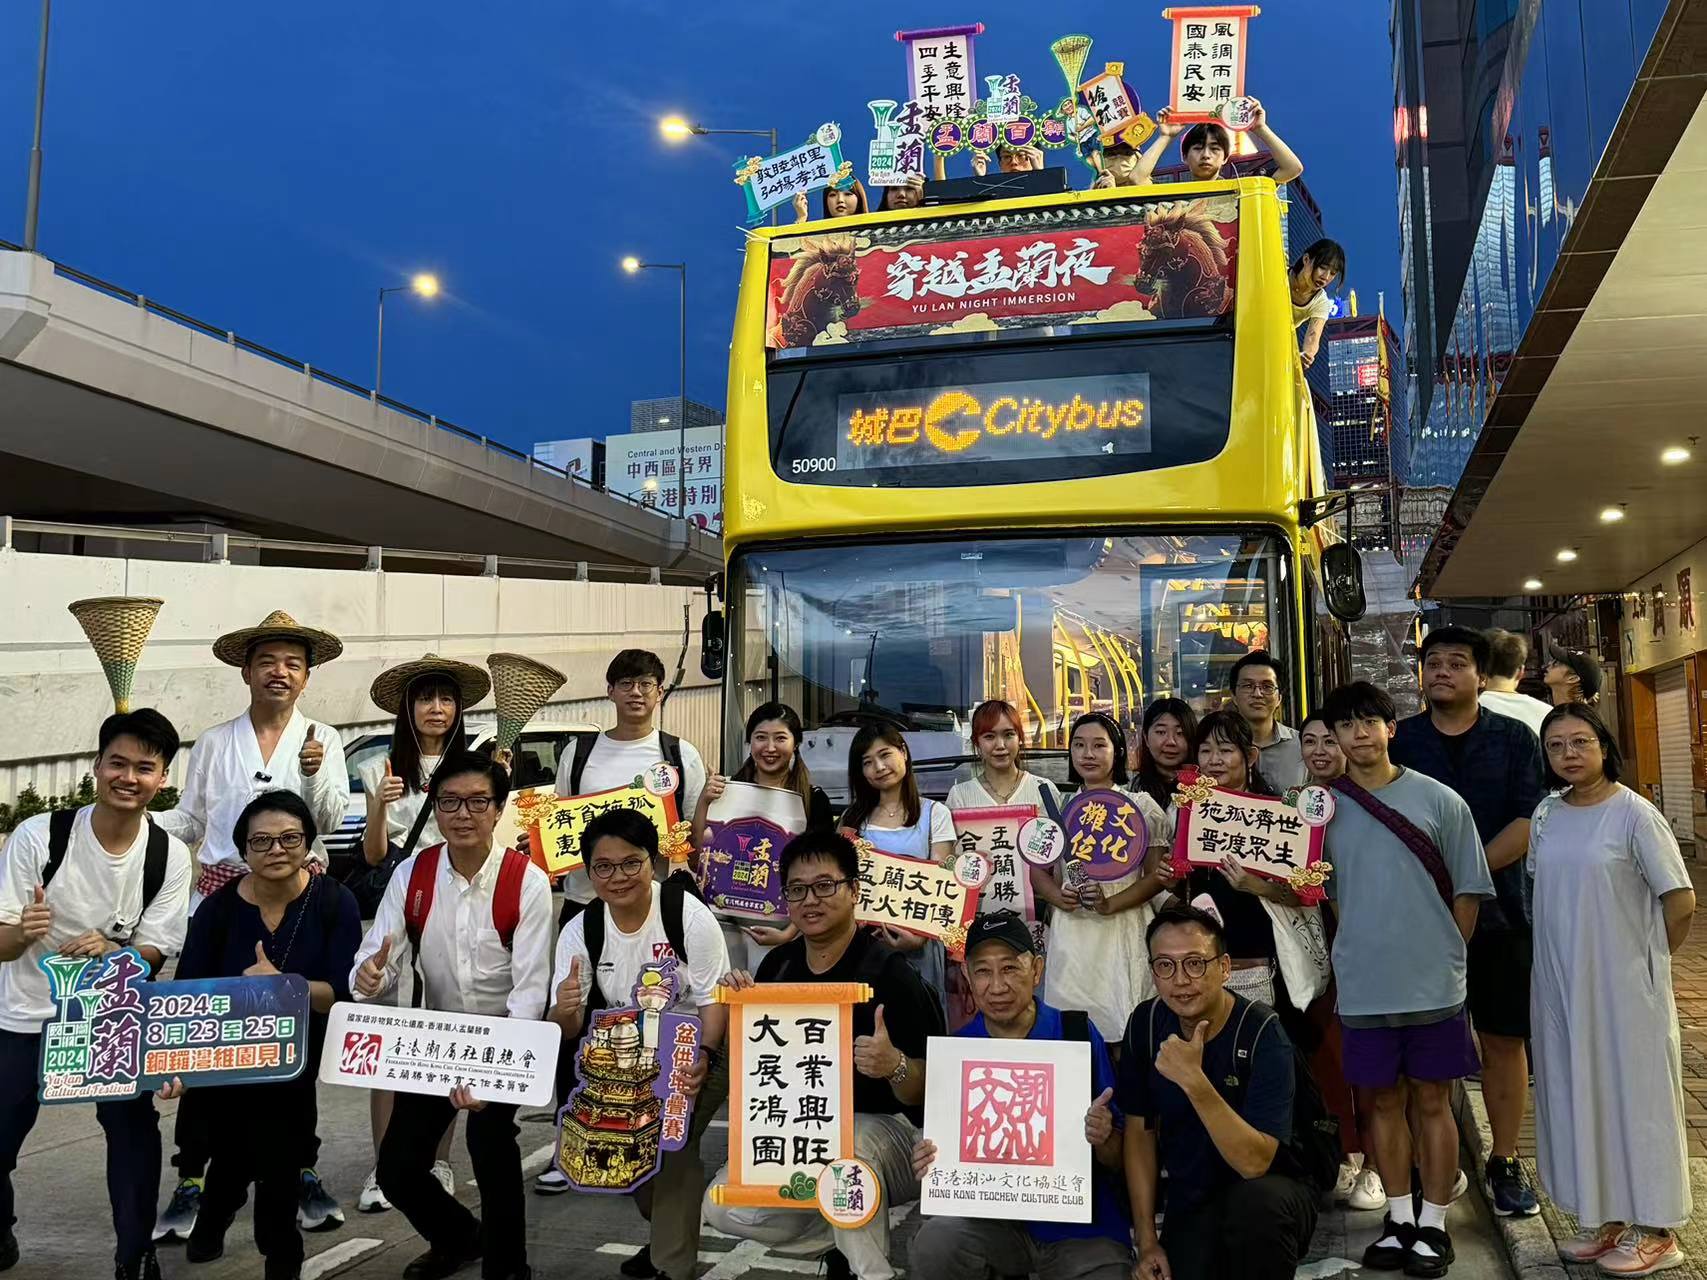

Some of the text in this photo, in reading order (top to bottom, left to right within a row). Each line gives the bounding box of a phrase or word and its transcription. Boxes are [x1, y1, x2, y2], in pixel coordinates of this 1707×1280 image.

[943, 41, 966, 119] 生意興隆
[1183, 24, 1207, 102] 國泰民安
[1210, 23, 1236, 102] 風調雨順
[918, 46, 943, 121] 四季平安
[1003, 75, 1020, 115] 盂蘭
[894, 102, 924, 174] 盂蘭
[872, 156, 892, 167] 2024
[882, 238, 1115, 300] 穿越盂蘭夜
[912, 292, 1076, 313] YU LAN NIGHT IMMERSION
[848, 407, 922, 445] 城巴
[984, 393, 1144, 439] Citybus
[627, 456, 712, 479] 中西區各界
[628, 449, 657, 458] Central
[660, 447, 675, 456] and
[791, 457, 836, 473] 50900
[1198, 799, 1303, 836] 施孤濟世
[750, 837, 773, 888] 盂蘭
[858, 859, 959, 901] 盂蘭文化
[87, 953, 144, 1077] 盂蘭
[149, 995, 231, 1018] 2024年
[147, 1017, 296, 1045] 8月23至25日
[48, 1051, 85, 1067] 2024
[388, 1036, 536, 1068] 香港潮屬社團總會
[44, 1081, 137, 1099] Cultural Festival
[748, 1014, 789, 1166] 大展鴻圖
[793, 1017, 835, 1166] 百業興旺
[847, 1165, 864, 1211] 盂蘭
[928, 1189, 1084, 1205] HONG KONG TEOCHEW CULTURE CLUB
